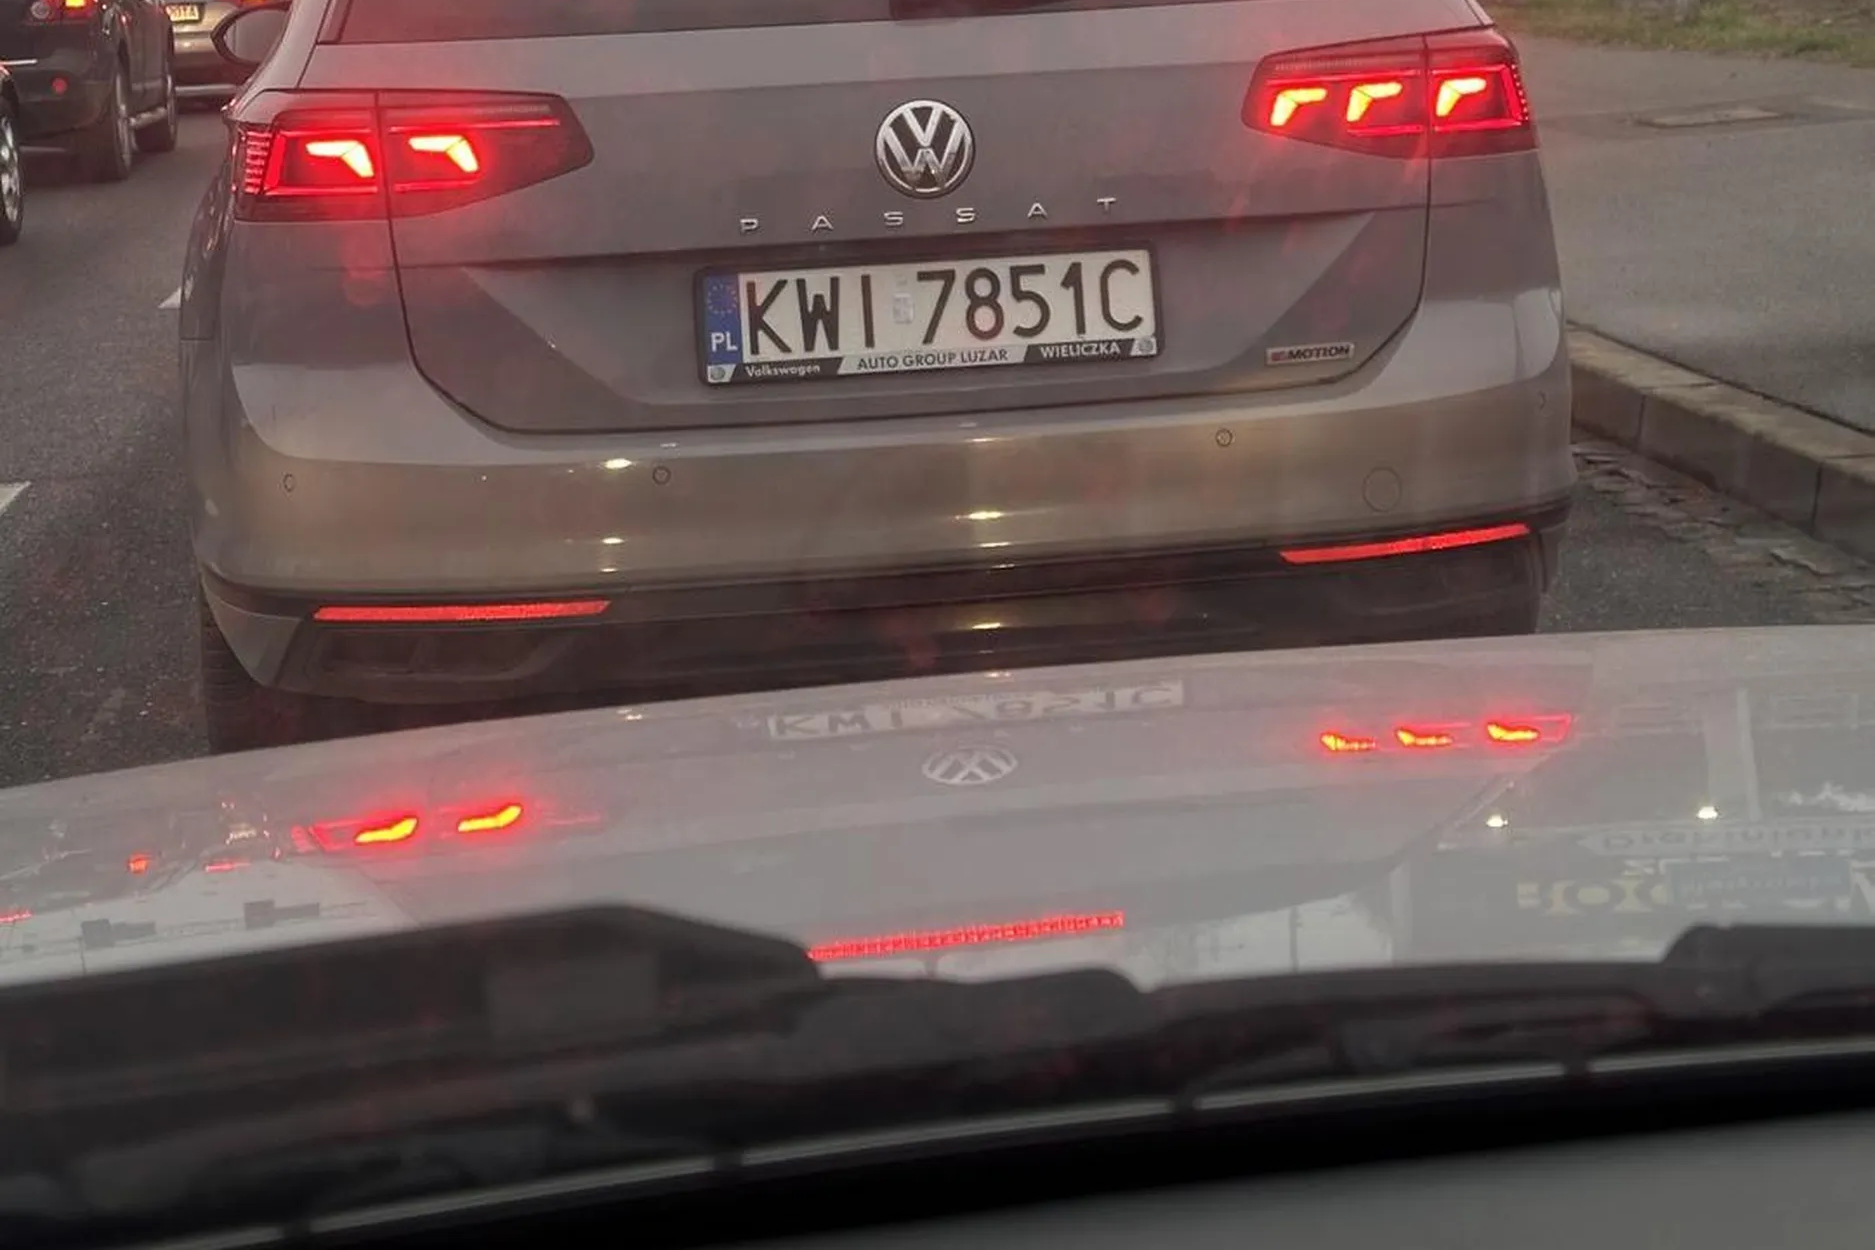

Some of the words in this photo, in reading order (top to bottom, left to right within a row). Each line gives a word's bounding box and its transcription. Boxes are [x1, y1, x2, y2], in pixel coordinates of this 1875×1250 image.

[740, 197, 1117, 232] PASSAT
[711, 332, 738, 351] PL
[746, 274, 875, 355] KWI
[917, 259, 1142, 344] 7851C
[745, 364, 820, 378] Volkswagen
[858, 354, 900, 370] AUTO
[903, 351, 957, 368] GROUP
[961, 348, 1008, 364] LUZAR
[1040, 340, 1121, 358] WIELICZKA
